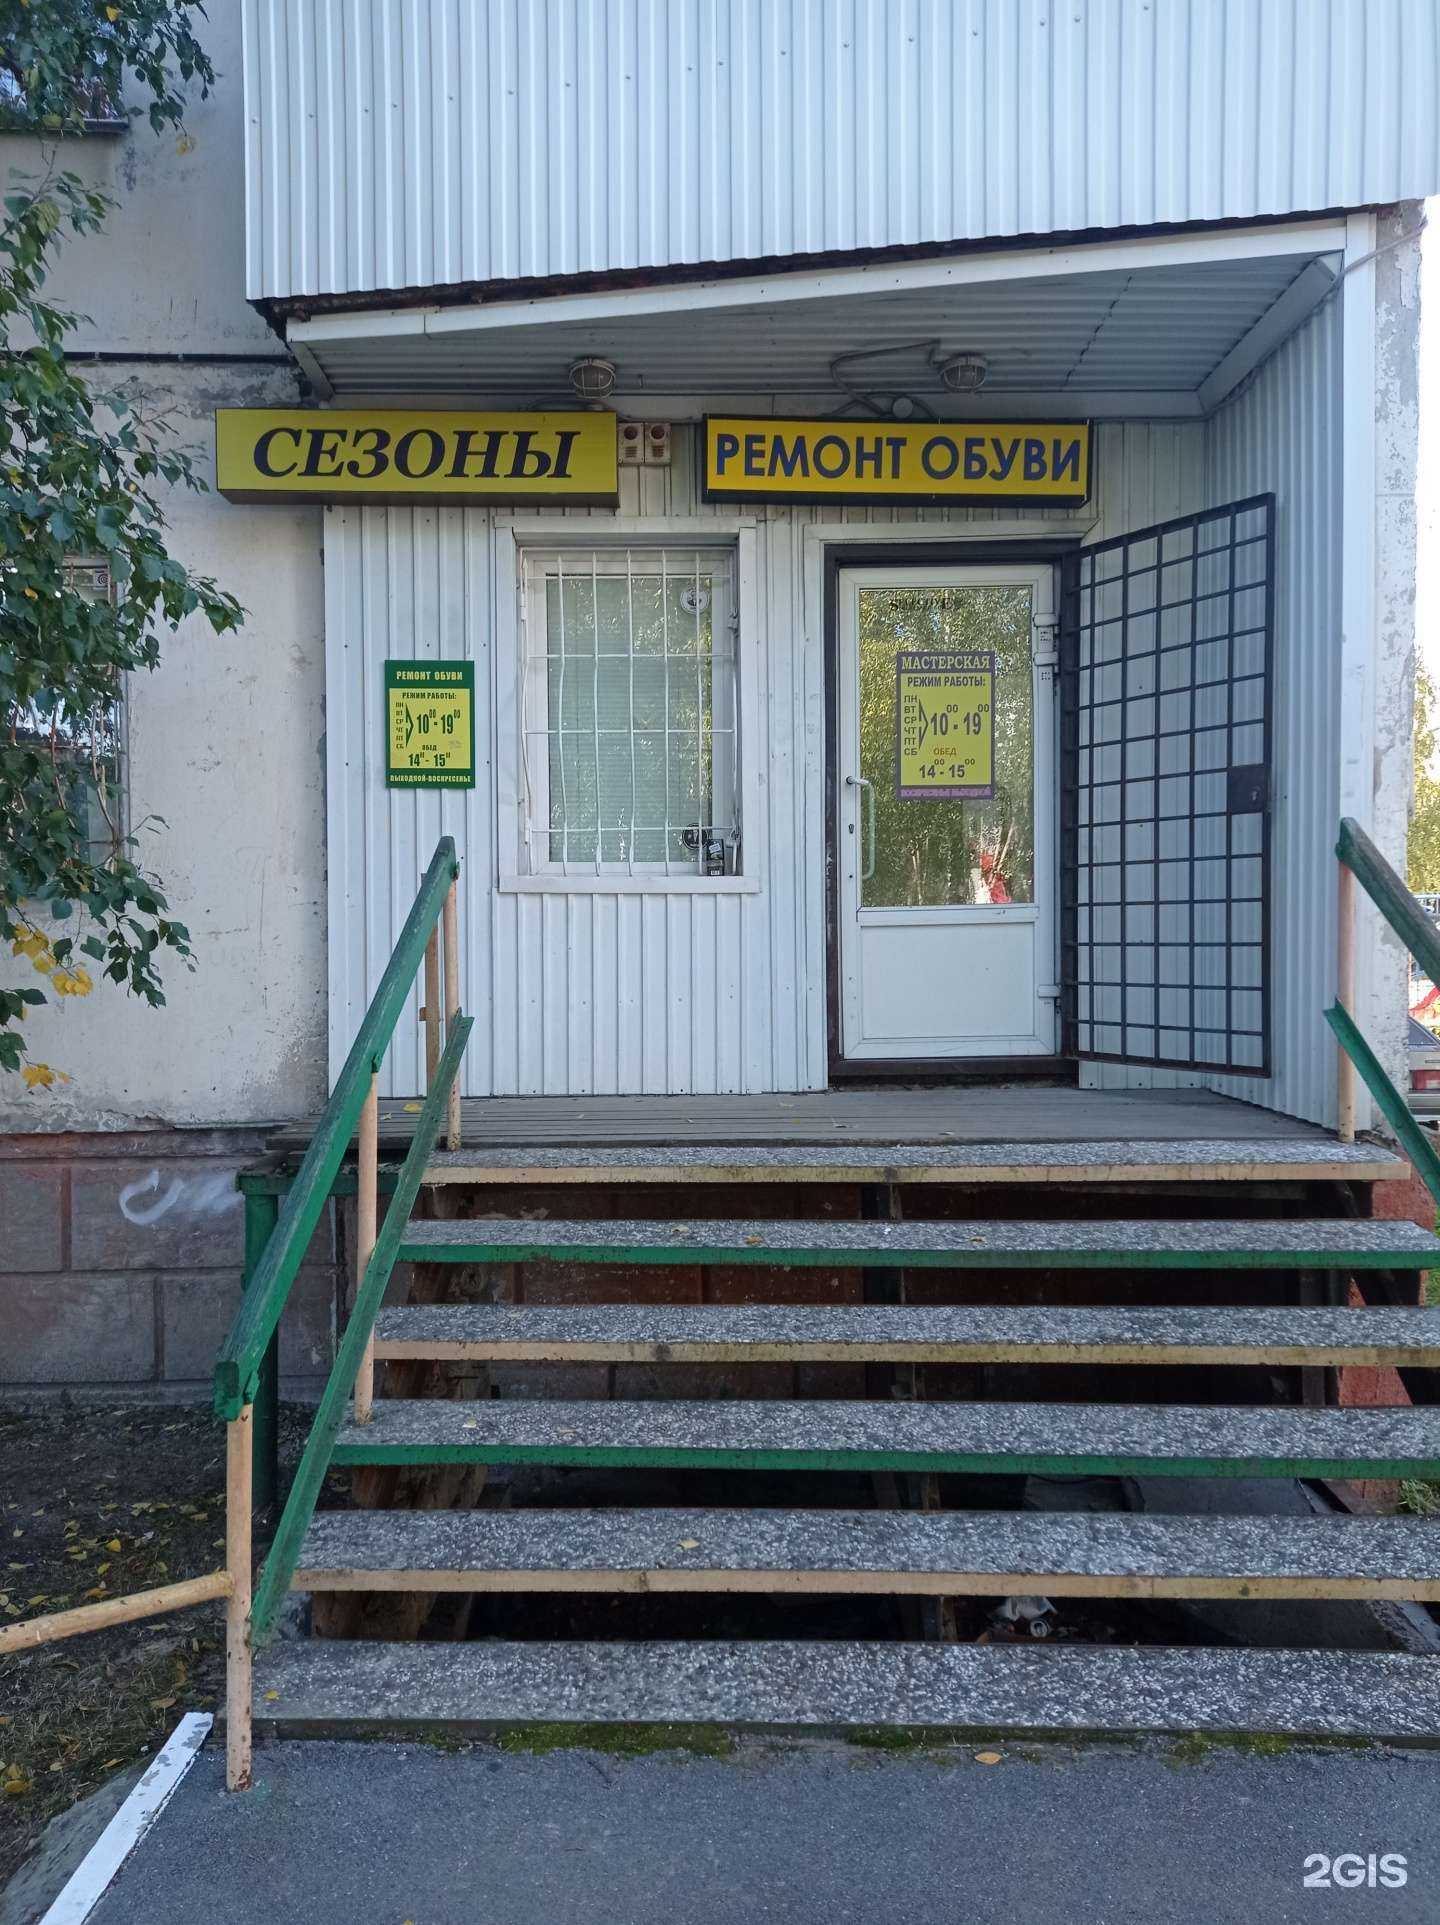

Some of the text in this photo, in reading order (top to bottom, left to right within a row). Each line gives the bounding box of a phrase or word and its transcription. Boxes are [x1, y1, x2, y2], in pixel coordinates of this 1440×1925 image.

[253, 427, 581, 479] СЕЗОНЫ
[715, 433, 1081, 482] РЕМОНТ ОБУВИ
[901, 655, 991, 670] МАСТЕРСКАЯ
[396, 671, 463, 680] РЕМОНТ ОБУВИ
[907, 676, 986, 687] РЕЖИМ РАБОТЫ:
[402, 692, 457, 700] РЕЖИМ РАБОТЫ:
[904, 695, 918, 703] ПН
[904, 716, 917, 724] СР
[904, 727, 917, 735] ЧТ
[904, 737, 916, 745] ПТ
[904, 748, 918, 756] СБ
[933, 748, 957, 756] ОБЕД
